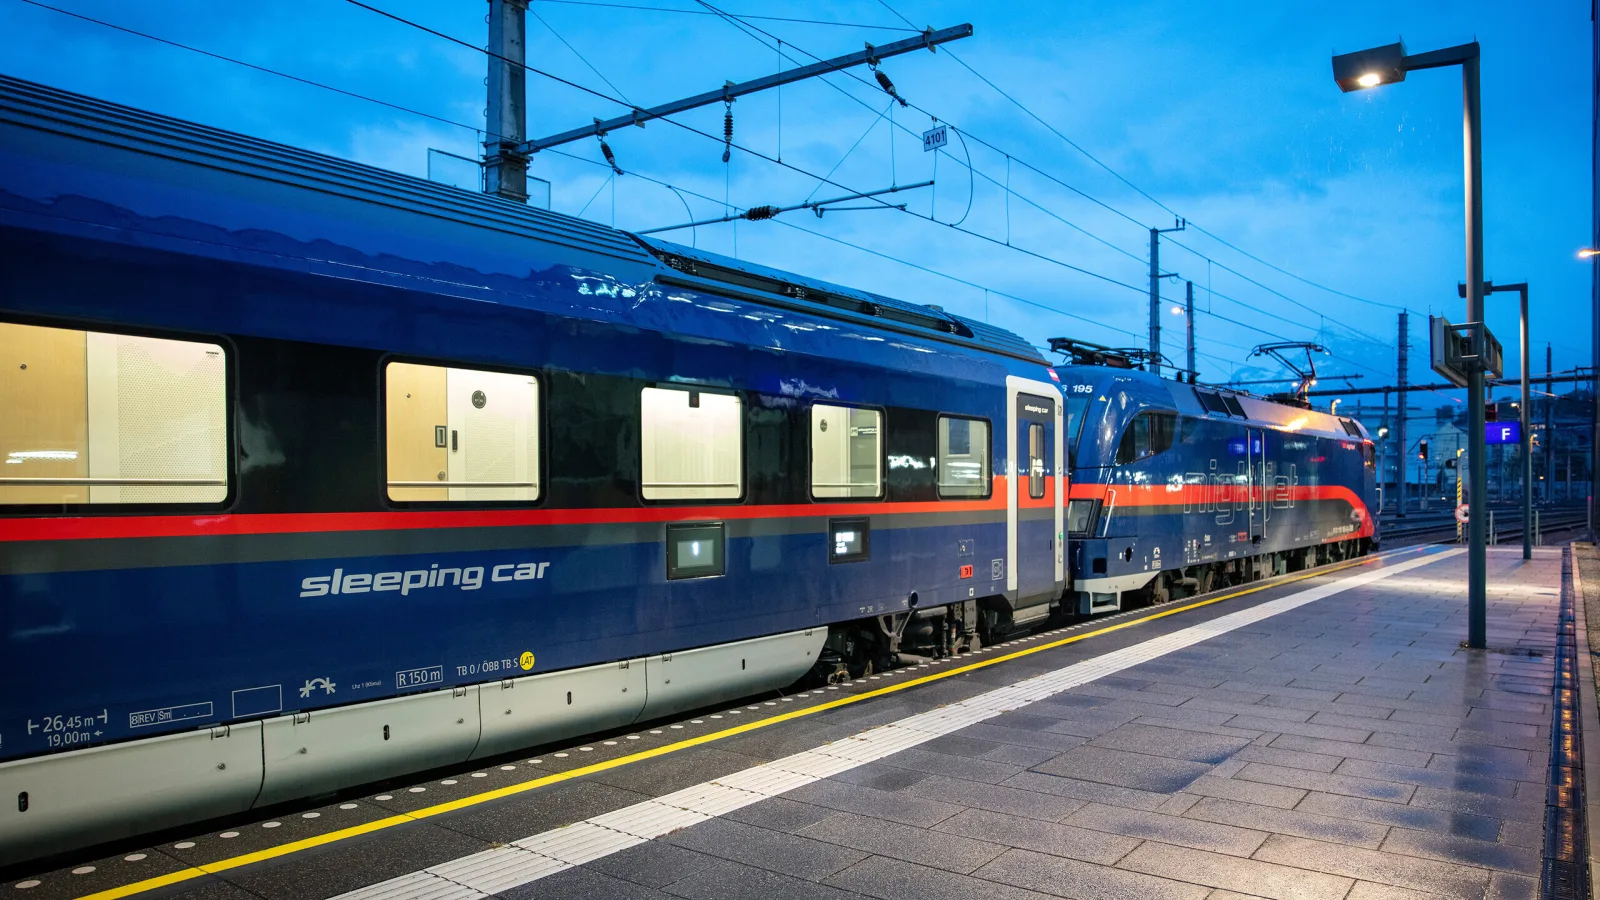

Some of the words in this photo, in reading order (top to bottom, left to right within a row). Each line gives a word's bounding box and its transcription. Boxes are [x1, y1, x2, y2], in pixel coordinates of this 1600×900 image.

[926, 129, 945, 145] 4101
[1072, 384, 1093, 393] 195
[1502, 428, 1510, 440] F
[300, 564, 484, 598] sleeping
[491, 562, 550, 582] car
[457, 666, 467, 676] TB
[482, 660, 499, 672] ÖBB
[501, 659, 511, 669] TB
[514, 657, 518, 667] S
[521, 656, 533, 666] LAT
[399, 673, 406, 685] R
[409, 670, 428, 684] 150
[430, 670, 440, 680] m
[43, 715, 81, 732] 26,45
[84, 717, 94, 726] m
[139, 712, 155, 723] REV
[159, 711, 171, 720] Sm
